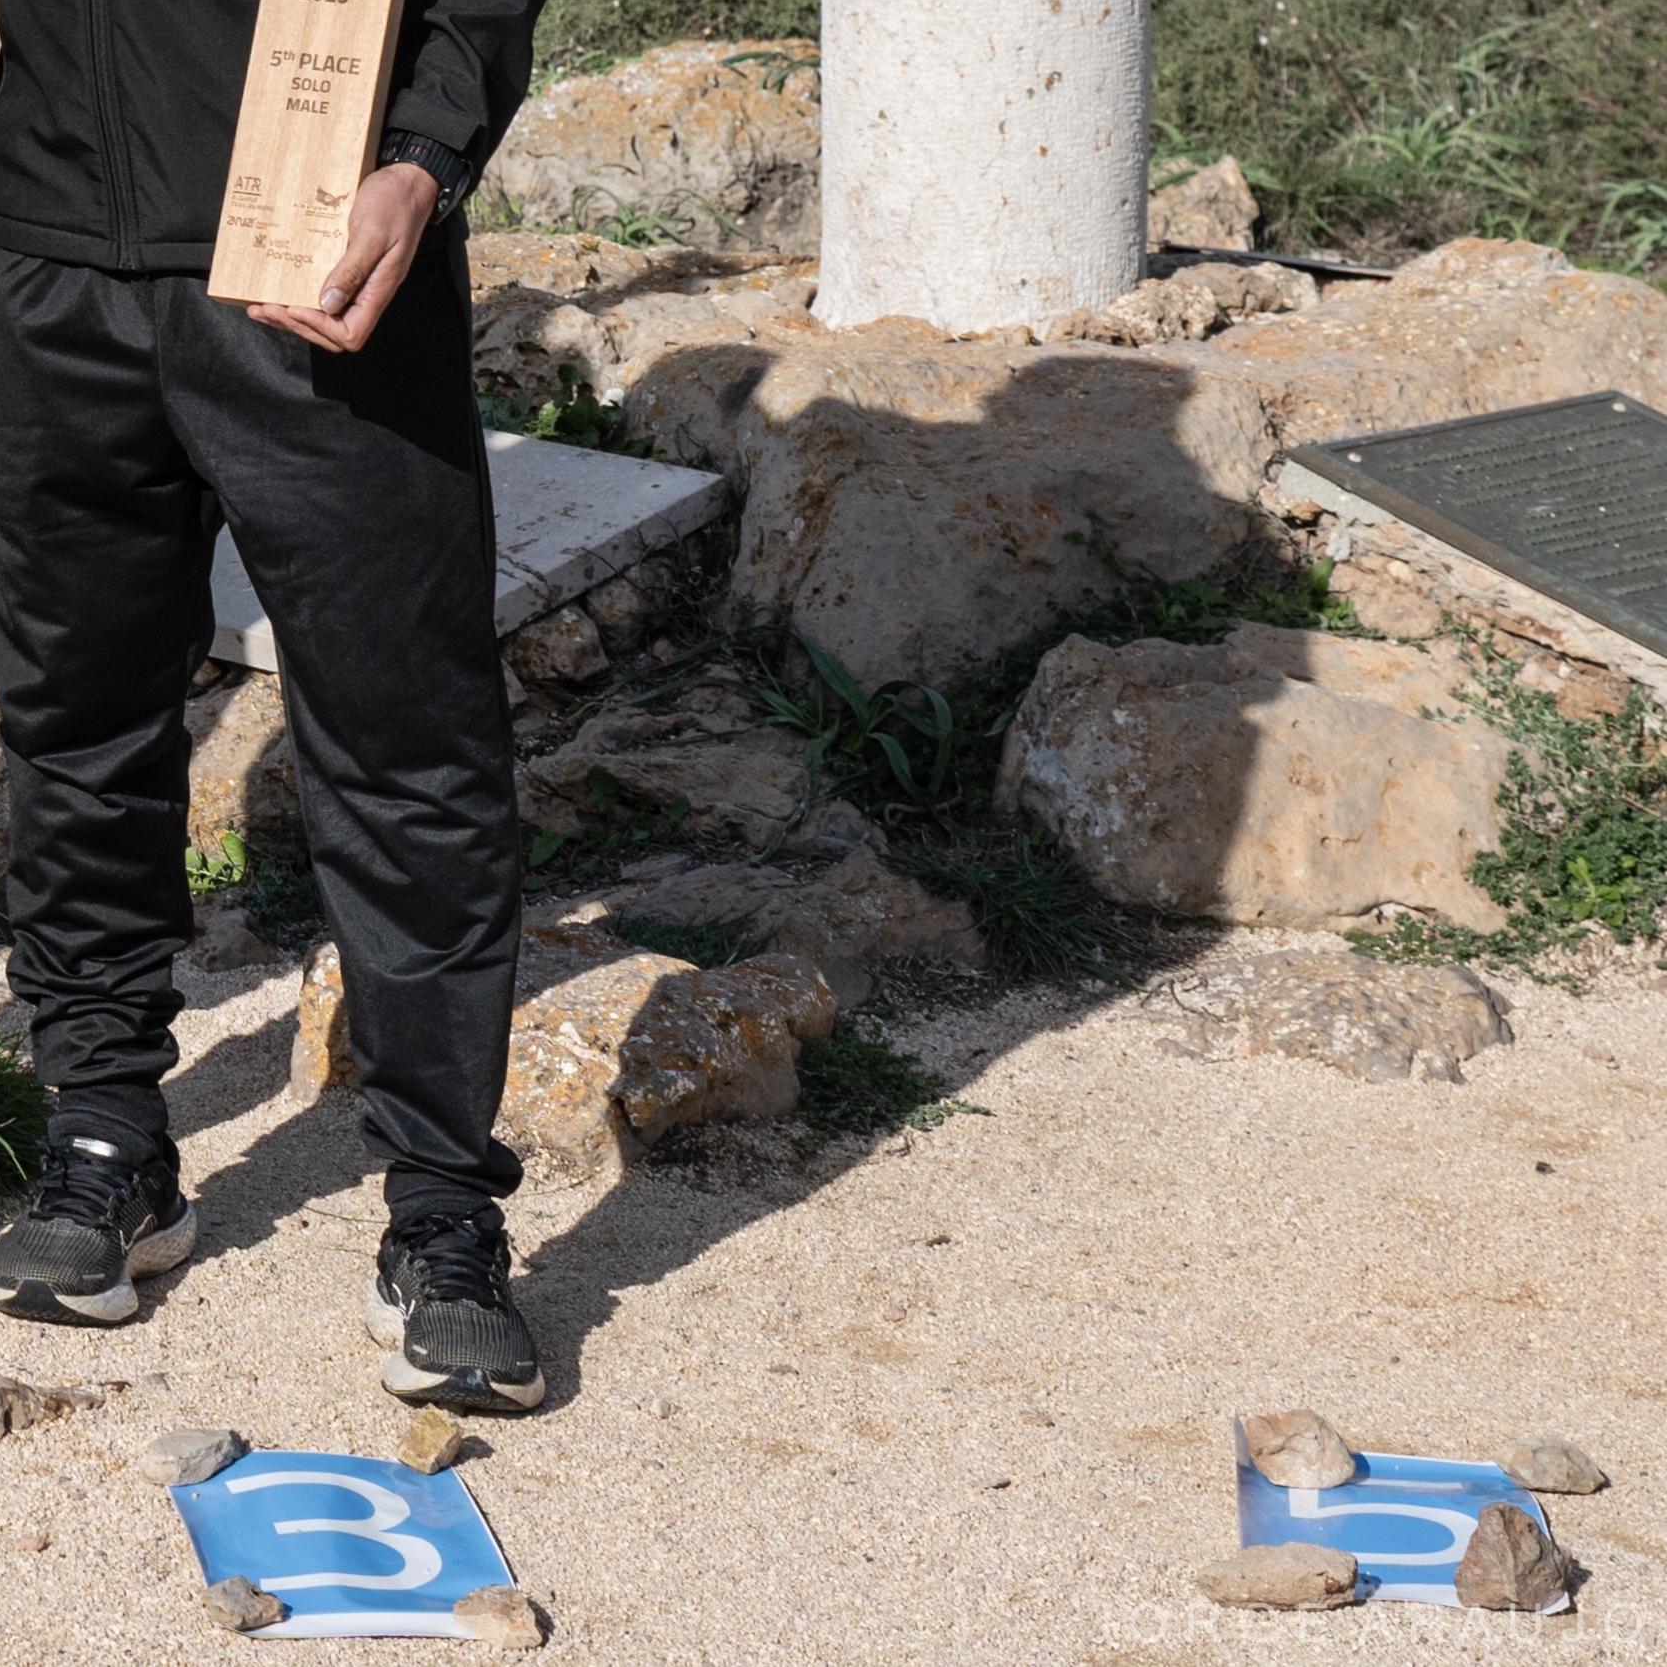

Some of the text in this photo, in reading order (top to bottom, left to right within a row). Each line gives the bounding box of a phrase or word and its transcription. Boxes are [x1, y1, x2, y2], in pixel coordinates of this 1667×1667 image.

[269, 49, 361, 75] 5th PLACE
[291, 77, 331, 94] SOLO
[286, 97, 329, 115] MALE
[225, 1470, 443, 1592] 3
[1287, 1477, 1480, 1567] 5
